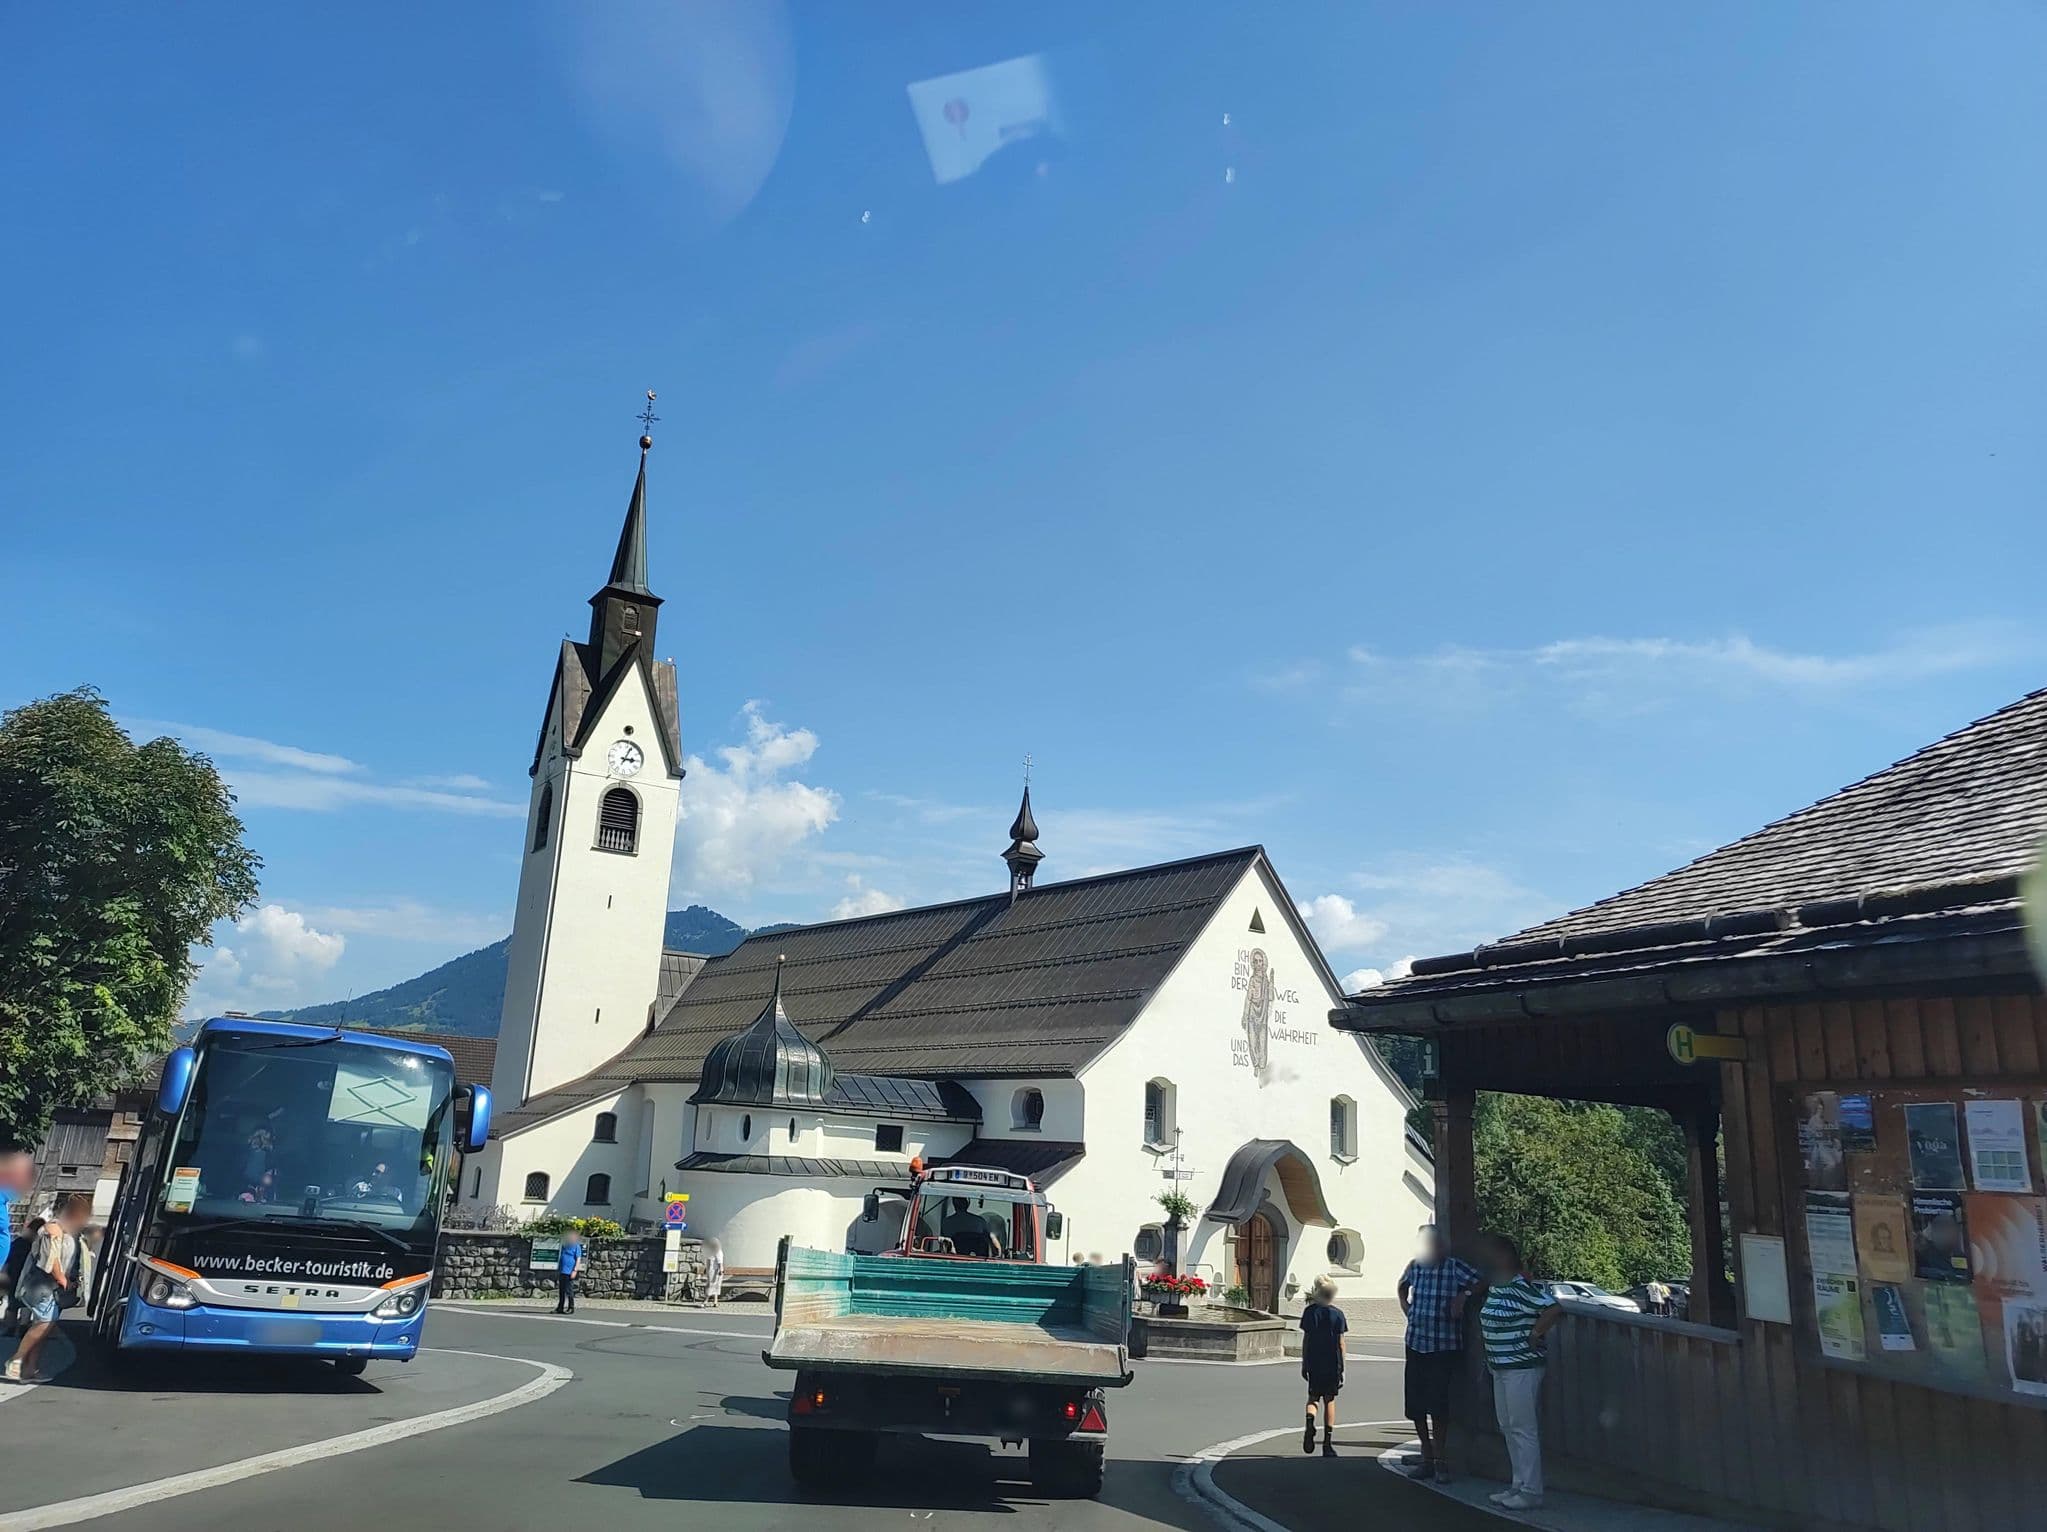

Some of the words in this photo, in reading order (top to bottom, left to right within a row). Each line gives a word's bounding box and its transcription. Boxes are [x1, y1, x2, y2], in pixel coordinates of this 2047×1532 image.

[1237, 949, 1250, 962] ICH
[1234, 962, 1250, 977] BIN
[1231, 976, 1249, 991] DER
[1274, 987, 1299, 1004] WEG
[1274, 1010, 1287, 1024] DIE
[1268, 1027, 1318, 1045] WAHRHEIT
[1230, 1038, 1249, 1053] UND
[1675, 1030, 1694, 1058] H
[1232, 1053, 1249, 1067] DAS
[193, 1254, 394, 1280] www.becker-touristik.de
[243, 1284, 340, 1298] SETRA
